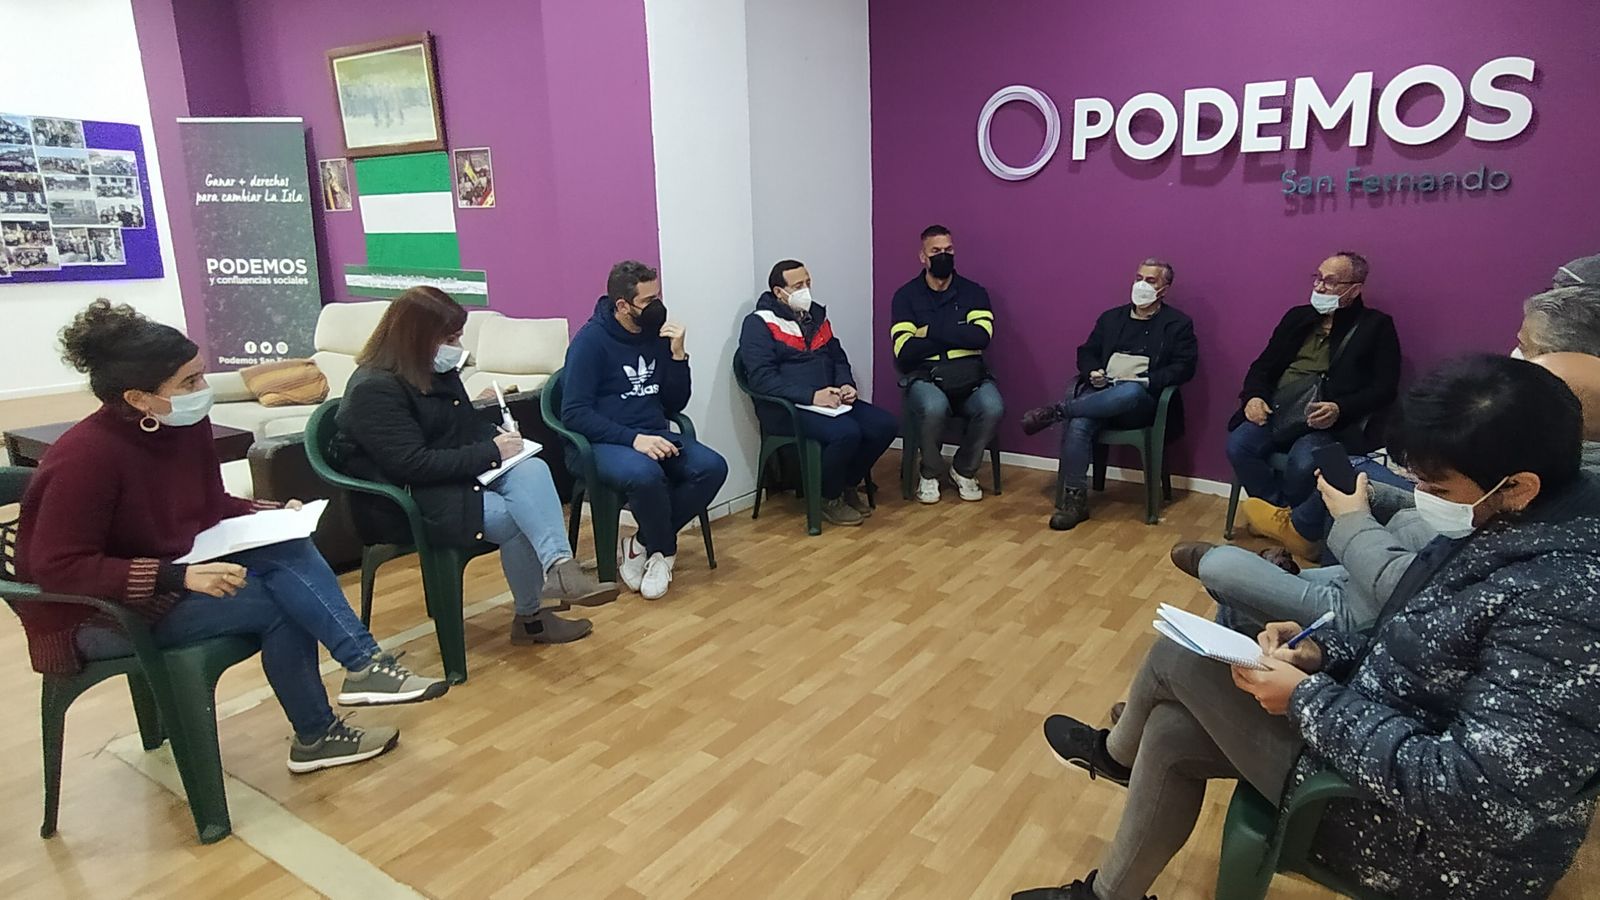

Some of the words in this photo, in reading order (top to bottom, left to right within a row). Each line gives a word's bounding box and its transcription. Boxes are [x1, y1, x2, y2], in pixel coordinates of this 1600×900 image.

[1072, 57, 1535, 161] PODEMOS
[205, 174, 235, 186] Ganar
[250, 174, 289, 186] derechos
[1280, 169, 1336, 195] San
[1345, 164, 1511, 194] Fernando
[196, 192, 219, 205] para
[221, 188, 262, 202] cambiar
[264, 189, 278, 202] La
[280, 189, 303, 202] Isla
[206, 258, 307, 274] PODEMOS
[209, 276, 215, 287] y
[216, 275, 272, 285] confluencias
[273, 276, 309, 285] sociales
[218, 356, 258, 365] Podemos
